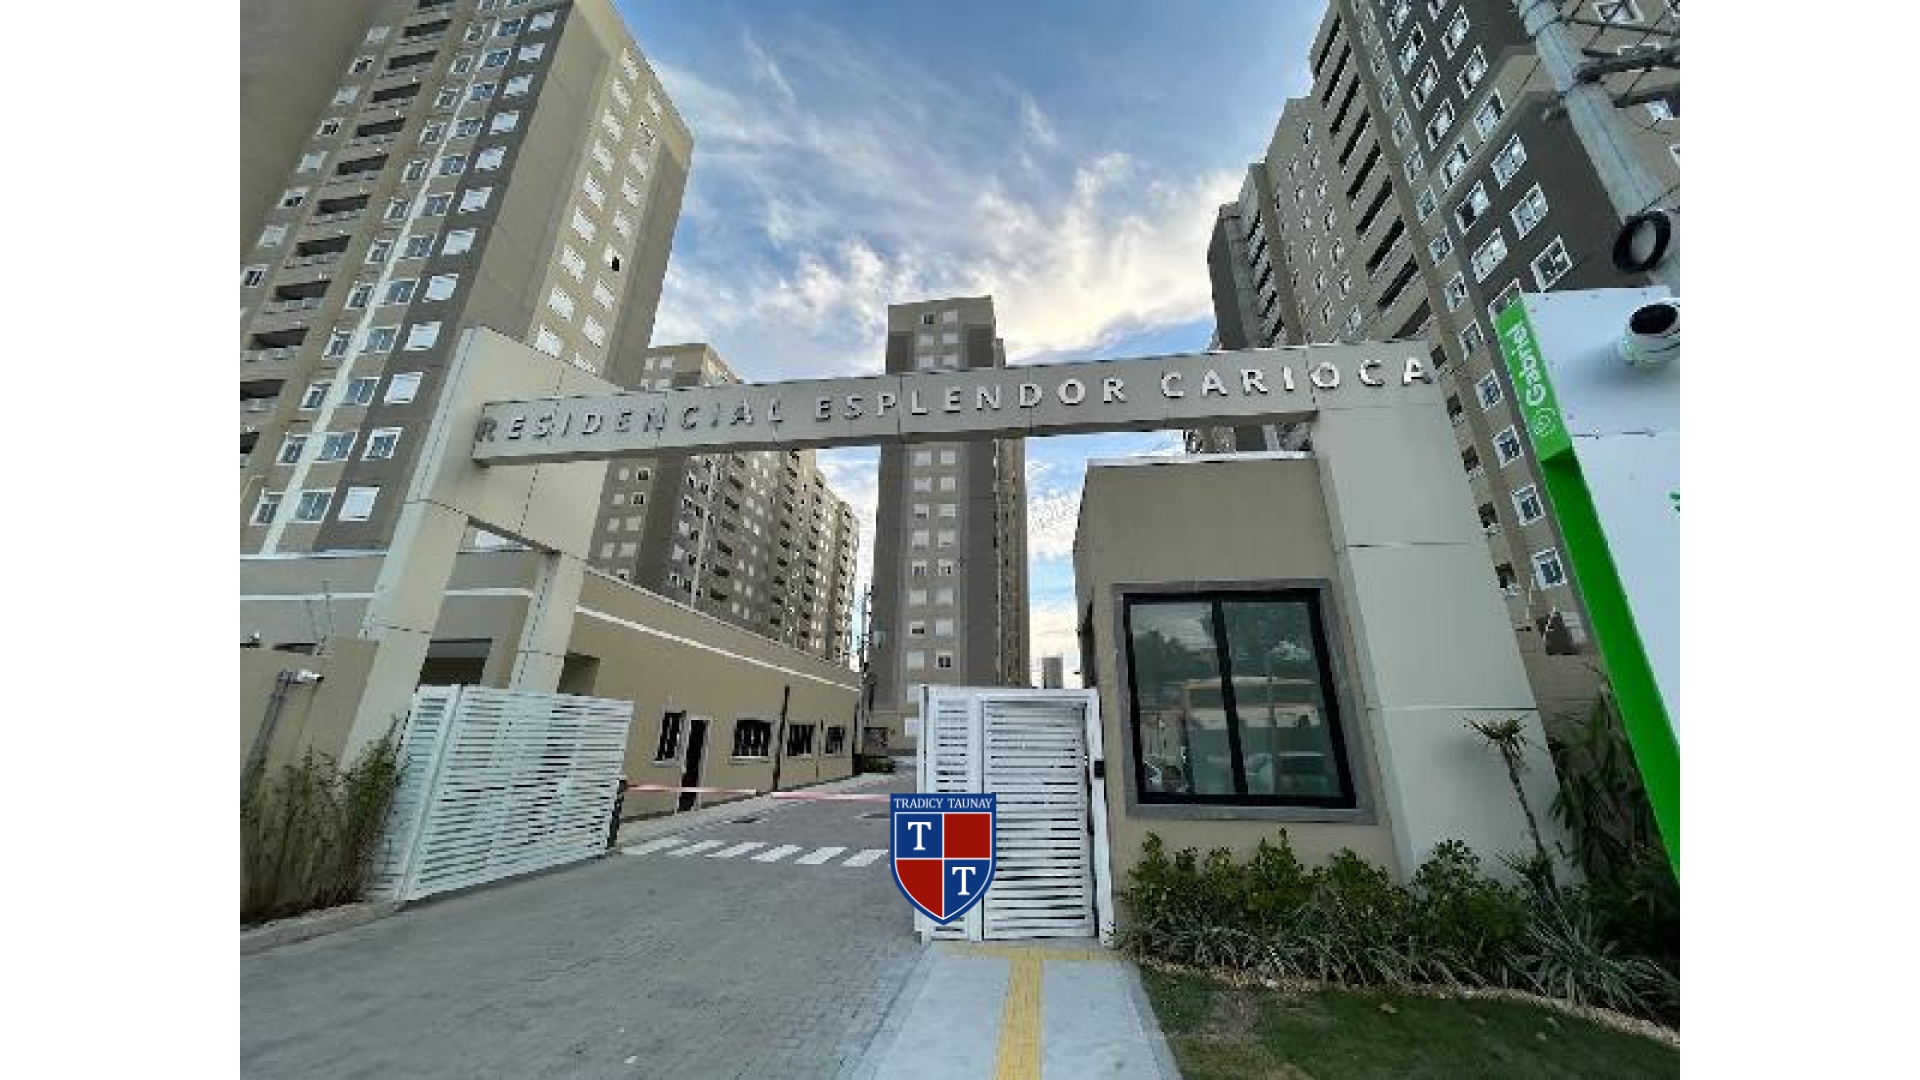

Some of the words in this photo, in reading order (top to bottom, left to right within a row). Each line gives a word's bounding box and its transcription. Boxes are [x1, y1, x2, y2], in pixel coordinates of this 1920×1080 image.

[475, 398, 783, 442] RESIDENCIAL
[815, 376, 1127, 422] ESPLENDOR
[1161, 356, 1434, 398] CARIOCA
[1505, 320, 1547, 407] Gabriel
